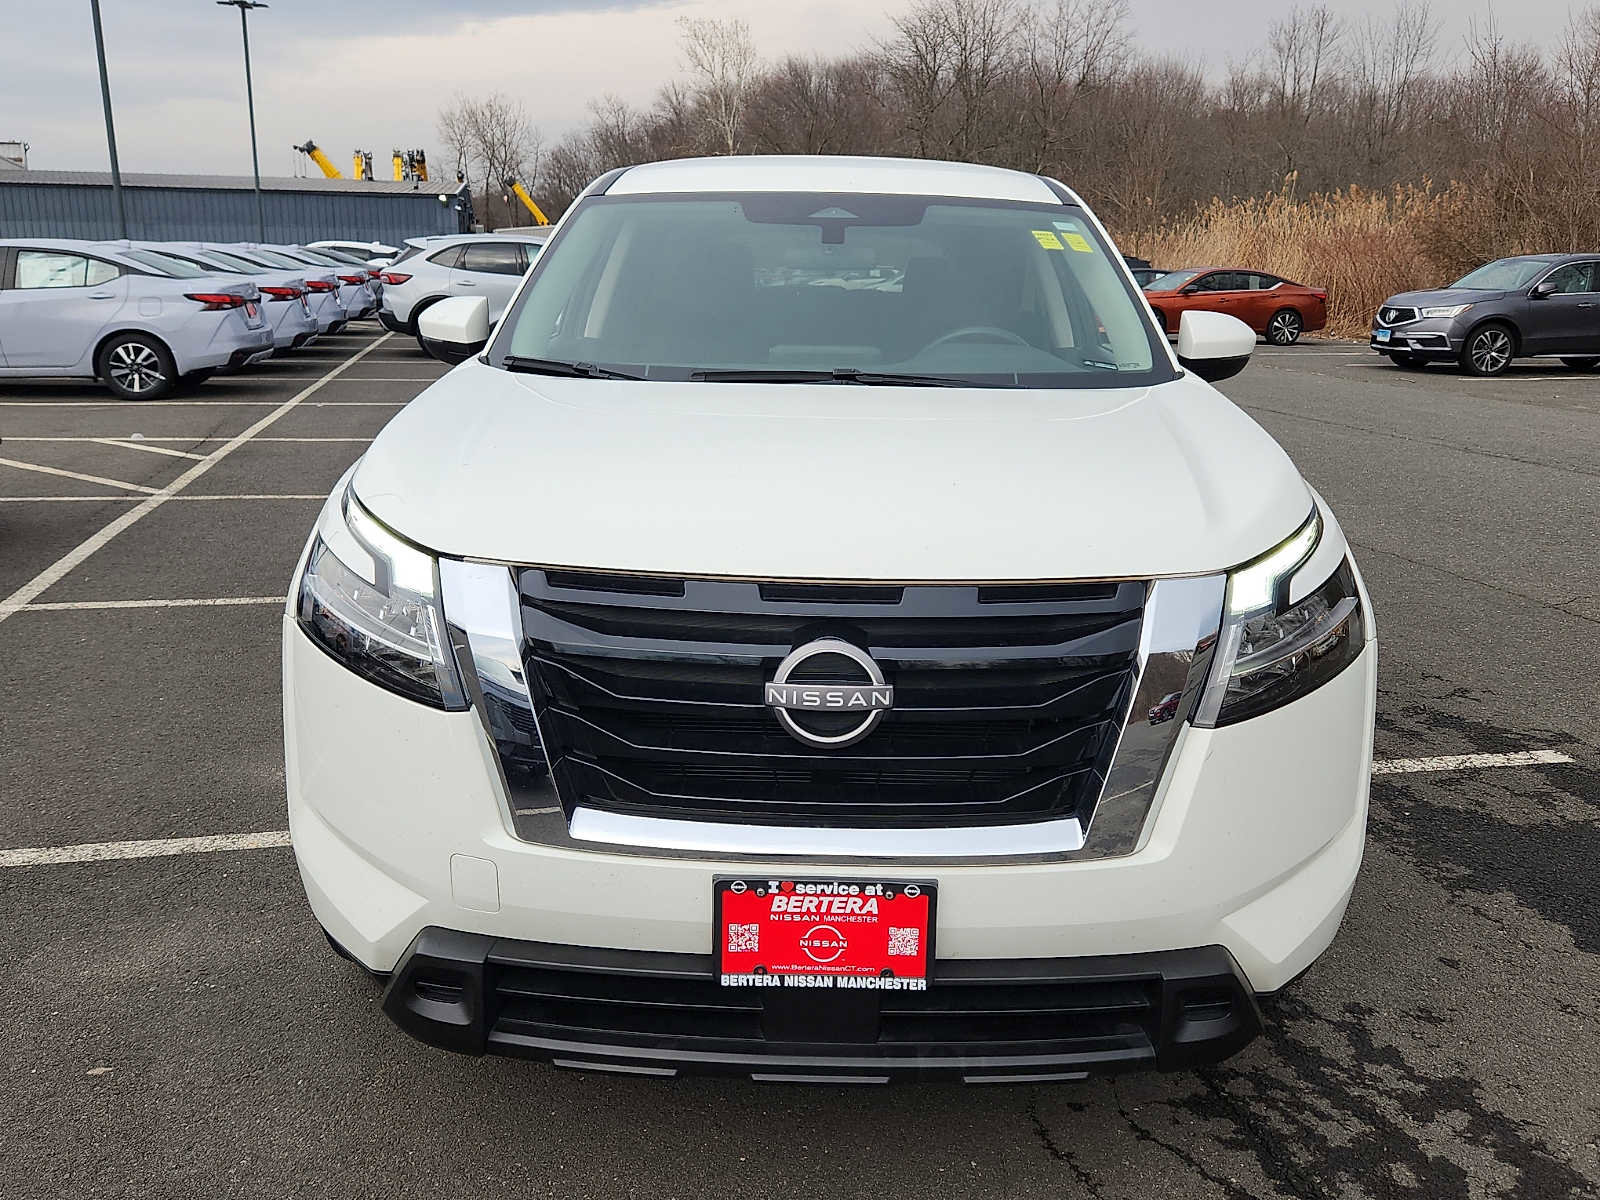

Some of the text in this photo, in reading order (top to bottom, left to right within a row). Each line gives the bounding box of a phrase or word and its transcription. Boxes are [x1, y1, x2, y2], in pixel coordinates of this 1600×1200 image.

[768, 688, 890, 707] NISSAN
[768, 881, 883, 896] I service at
[770, 896, 879, 914] BERTERA
[770, 914, 878, 923] NISSAN MANCHESTER
[800, 939, 848, 948] NISSAN
[771, 964, 875, 972] www.BerteraNissanCT.com
[721, 974, 927, 990] BERTERA NISSAN MANCHESTER
